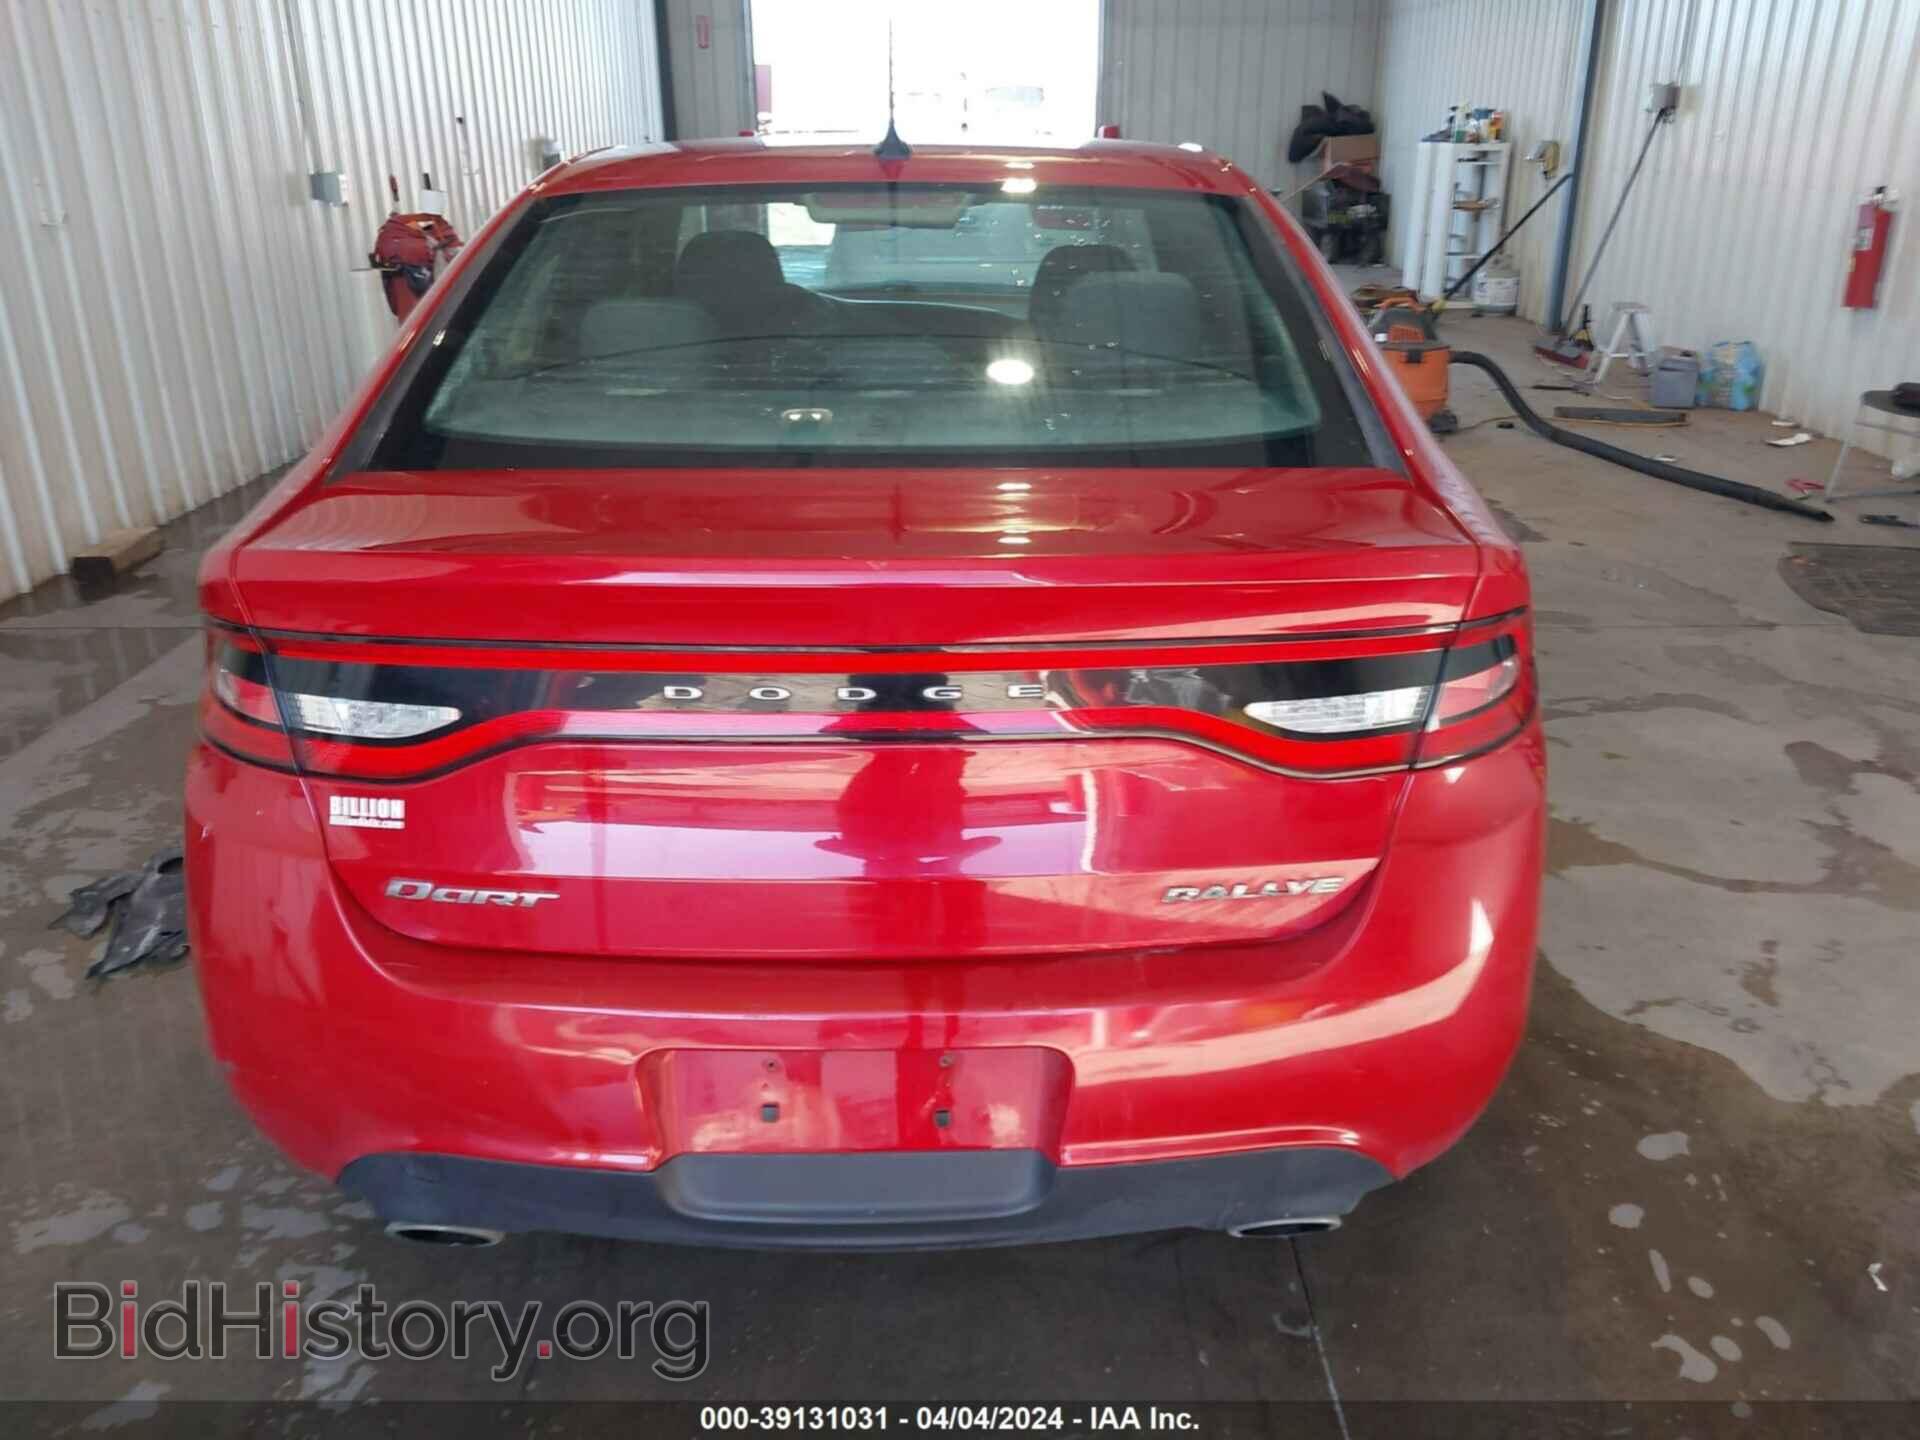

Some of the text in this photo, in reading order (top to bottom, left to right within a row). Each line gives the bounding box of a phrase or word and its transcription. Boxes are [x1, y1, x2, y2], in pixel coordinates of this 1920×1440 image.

[664, 685, 1043, 700] DODGE
[329, 796, 405, 819] BILLION
[1161, 876, 1345, 903] RALLYE
